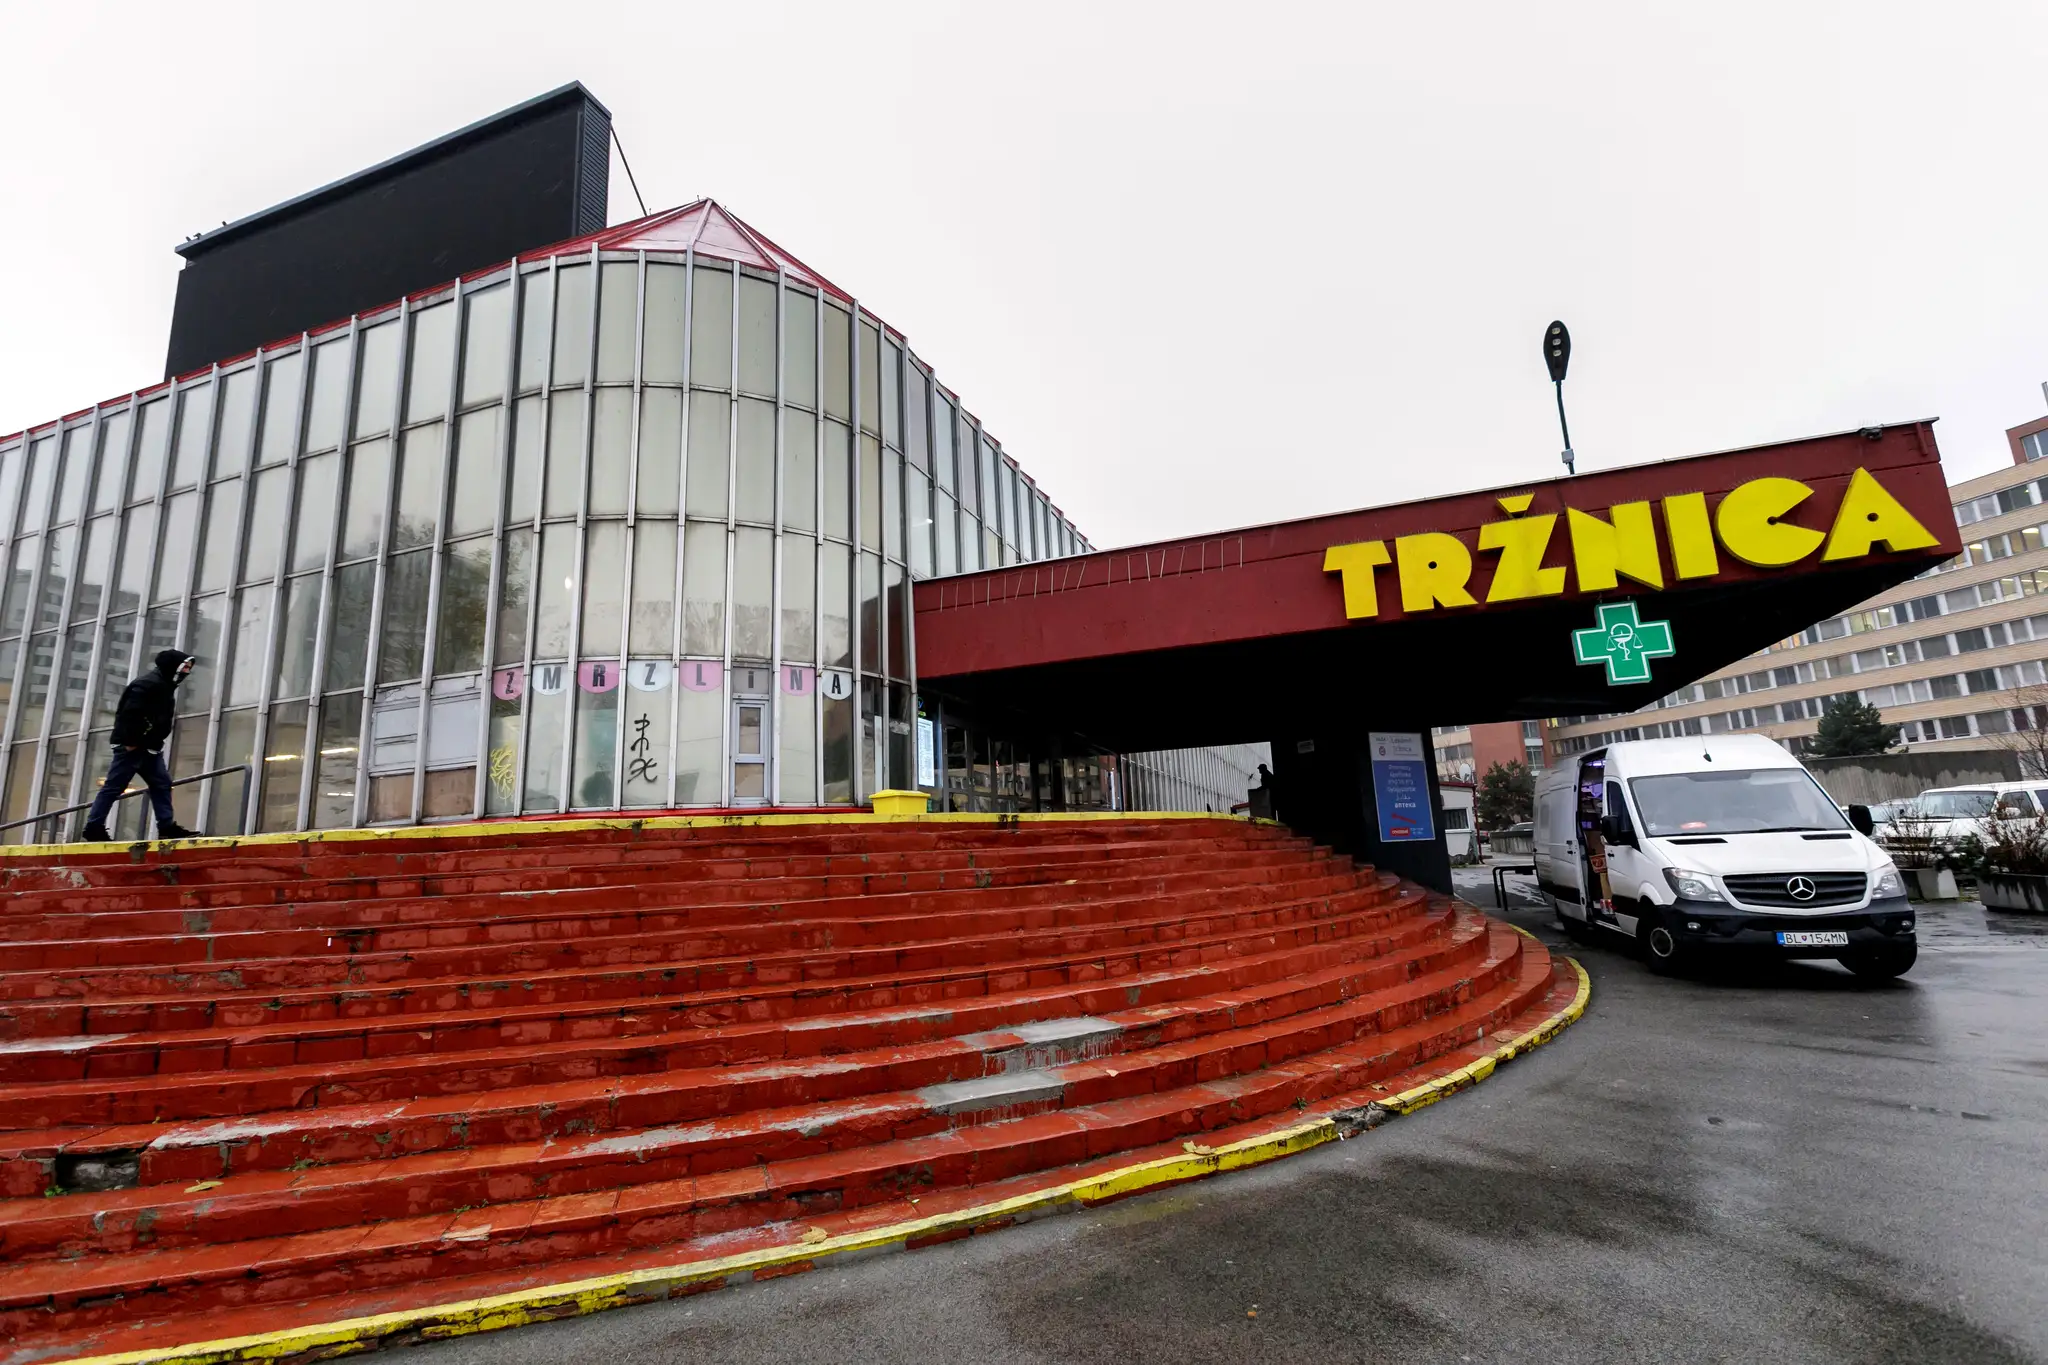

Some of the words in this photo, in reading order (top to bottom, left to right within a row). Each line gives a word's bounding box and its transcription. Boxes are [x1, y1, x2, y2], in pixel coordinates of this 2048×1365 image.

[1324, 467, 1941, 620] TRŽNICA
[1785, 933, 1802, 943] BL
[1809, 933, 1847, 943] 154MN
